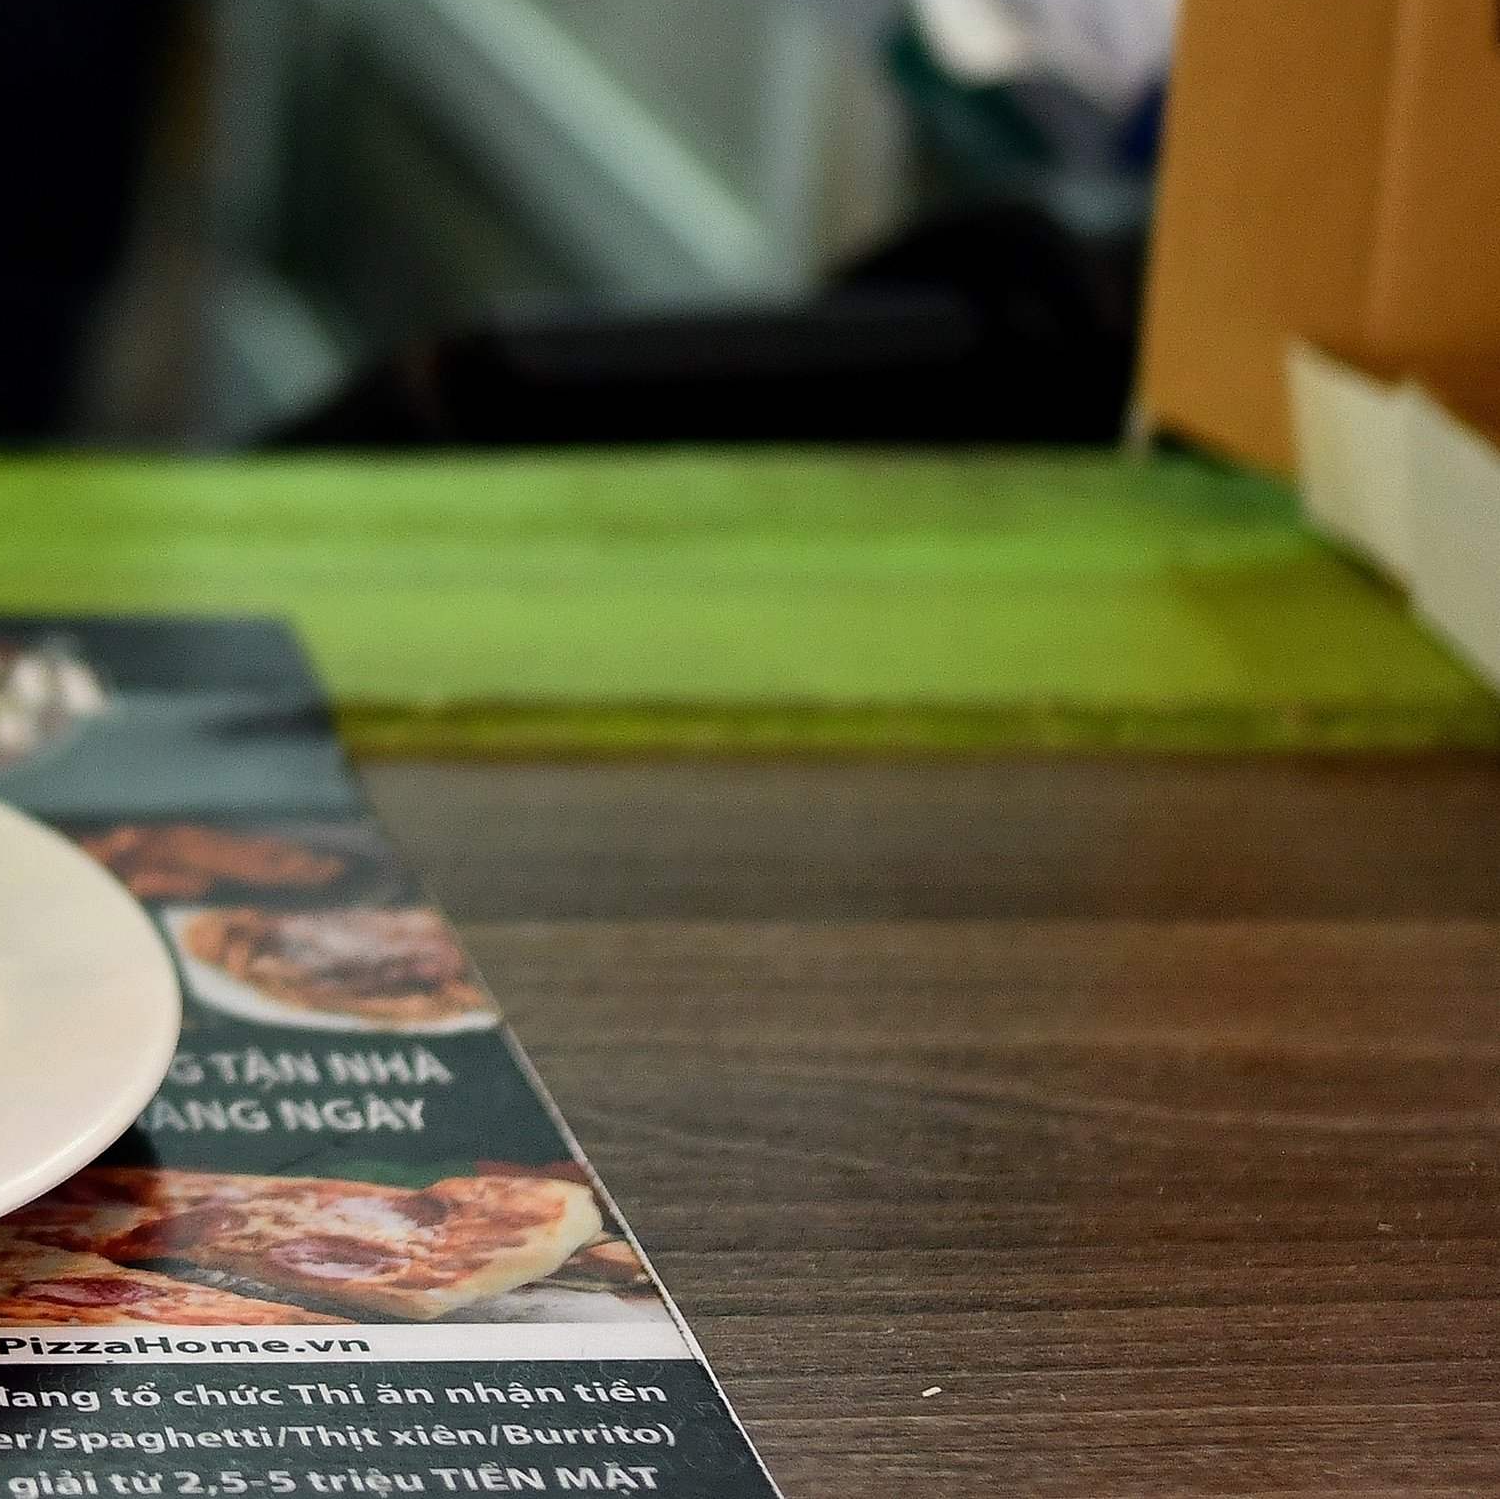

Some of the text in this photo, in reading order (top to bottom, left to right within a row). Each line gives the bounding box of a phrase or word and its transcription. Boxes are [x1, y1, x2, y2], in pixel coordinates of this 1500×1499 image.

[211, 1046, 321, 1091] TẬN
[327, 1044, 453, 1085] NHÀ
[279, 1093, 425, 1132] NGÀY
[109, 1381, 161, 1407] tổ
[173, 1384, 284, 1407] chức
[287, 1384, 366, 1405] Thi
[376, 1383, 436, 1405] ăn
[444, 1381, 567, 1409] nhận
[571, 1379, 668, 1403] tiền
[388, 1423, 676, 1448] xiên/Burrito)
[7, 1468, 100, 1499] giải
[107, 1469, 164, 1496] từ
[173, 1469, 298, 1497] 2,5-5
[306, 1467, 426, 1499] triệu
[430, 1460, 548, 1492] TIỀN
[555, 1460, 660, 1496] MẶT
